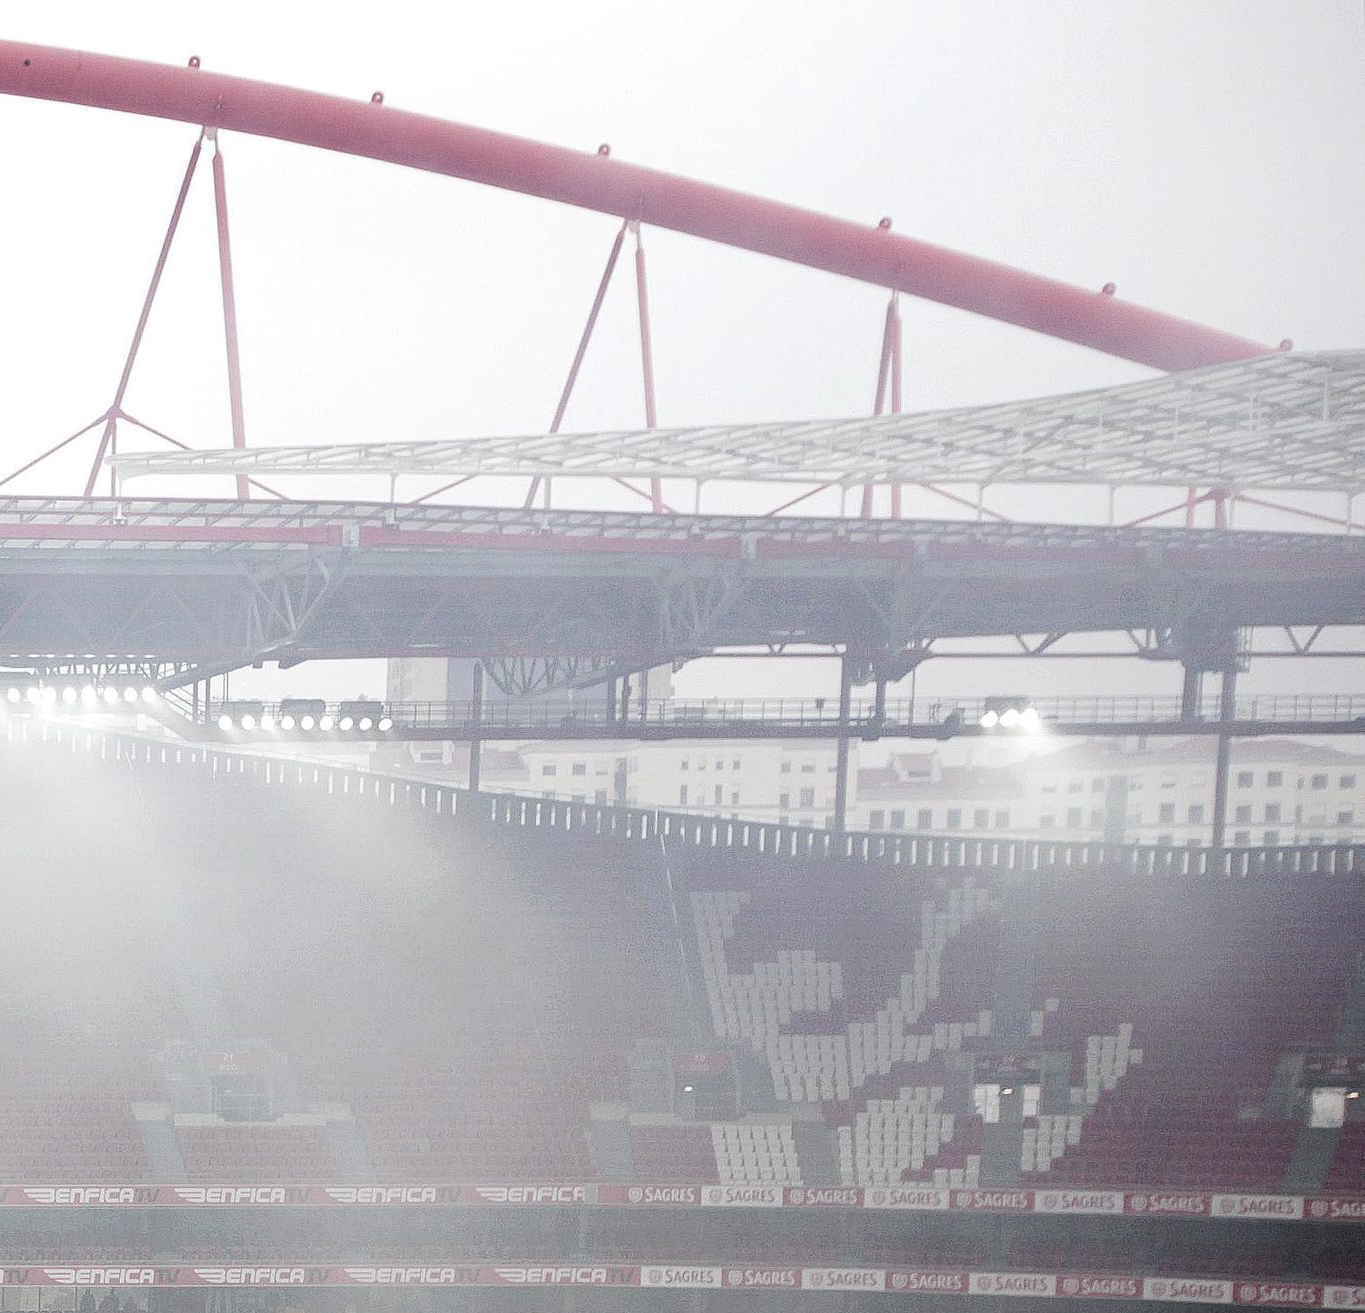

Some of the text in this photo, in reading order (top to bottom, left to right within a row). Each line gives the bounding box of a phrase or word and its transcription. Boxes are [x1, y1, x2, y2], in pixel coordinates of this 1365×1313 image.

[22, 1188, 134, 1203] BENFICA
[174, 1188, 285, 1203] BENFICA
[325, 1188, 436, 1203] BENFICA
[1331, 1200, 1365, 1217] SAG
[43, 1269, 154, 1283] BENFICA
[194, 1269, 305, 1283] BENFICA
[345, 1268, 455, 1283] BENFICA
[495, 1268, 606, 1283] BENFICA
